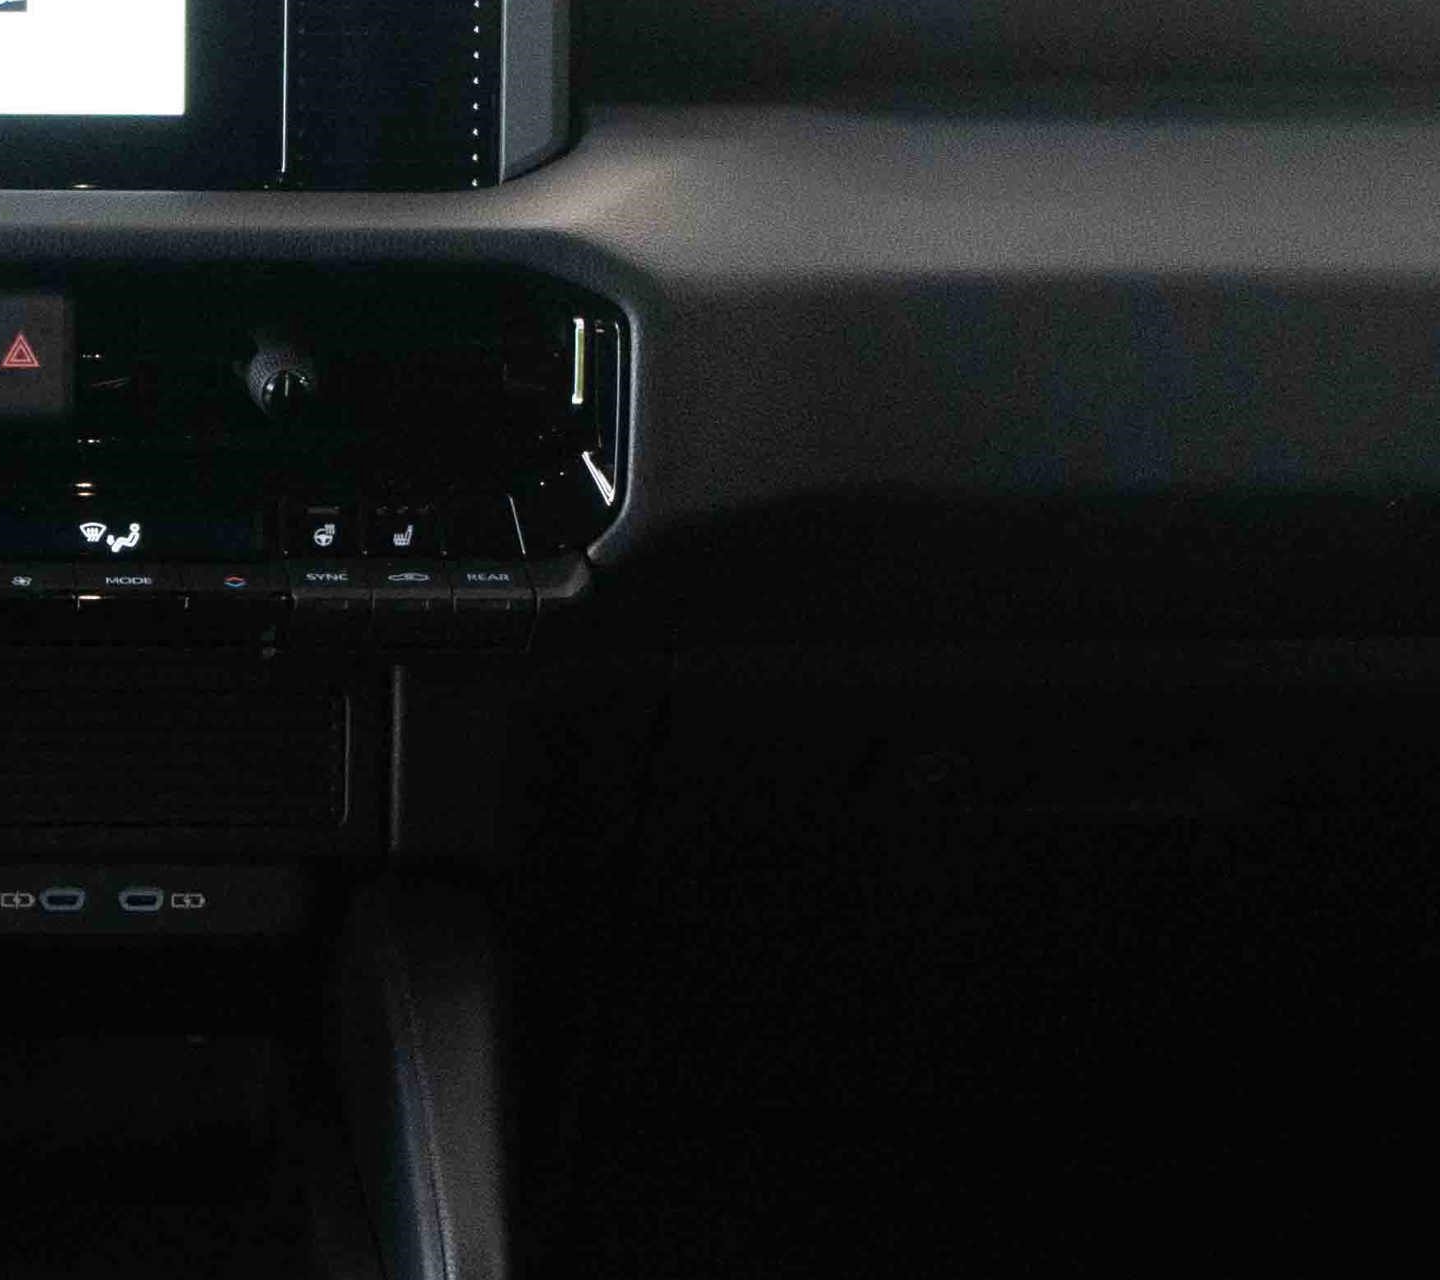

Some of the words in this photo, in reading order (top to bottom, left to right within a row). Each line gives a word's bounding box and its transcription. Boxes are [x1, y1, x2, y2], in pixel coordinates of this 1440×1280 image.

[105, 575, 153, 586] MODE
[305, 572, 349, 582] SYNC
[466, 572, 511, 582] REAR
